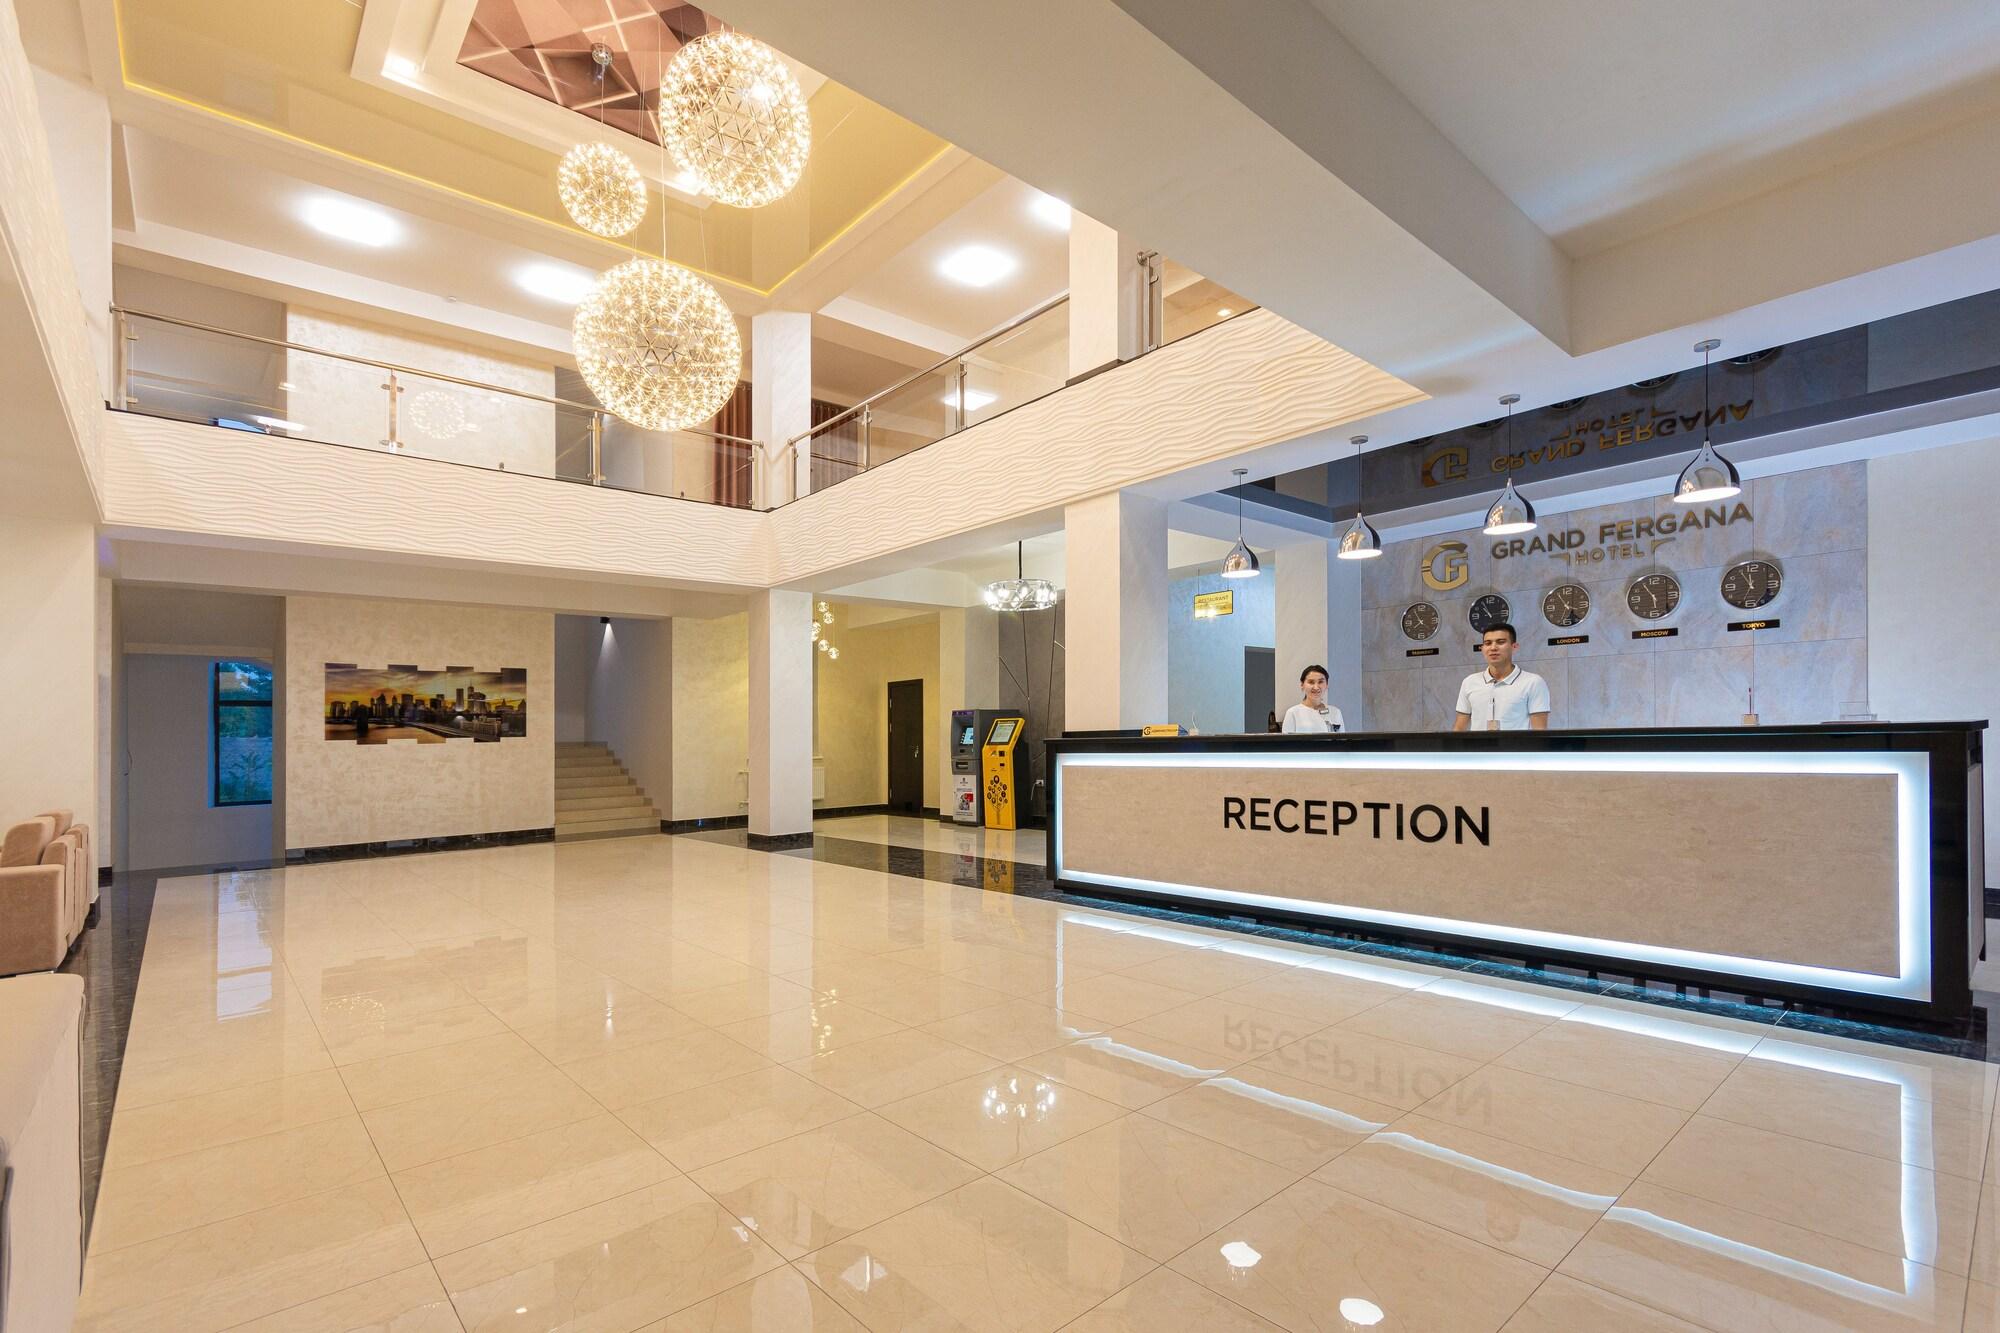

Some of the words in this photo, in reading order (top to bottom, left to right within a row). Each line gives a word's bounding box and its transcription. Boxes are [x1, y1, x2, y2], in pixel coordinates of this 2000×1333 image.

[1491, 530, 1585, 560] GRAND
[1599, 502, 1754, 545] FERGANA
[1575, 544, 1644, 566] HOTEL
[1746, 564, 1760, 573] 12
[1648, 577, 1660, 585] 12
[1767, 580, 1780, 589] 3
[1562, 587, 1573, 595] 12
[1725, 583, 1736, 592] 9
[1485, 596, 1495, 604] 12
[1630, 595, 1641, 604] 9
[1667, 591, 1678, 600] 3
[1546, 604, 1555, 612] 9
[1579, 600, 1589, 609] 3
[1745, 599, 1757, 608] 6
[1471, 612, 1480, 620] 9
[1501, 609, 1509, 617] 3
[1649, 609, 1660, 618] 6
[1742, 621, 1766, 629] TOKYO
[1223, 796, 1491, 846] RECEPTION
